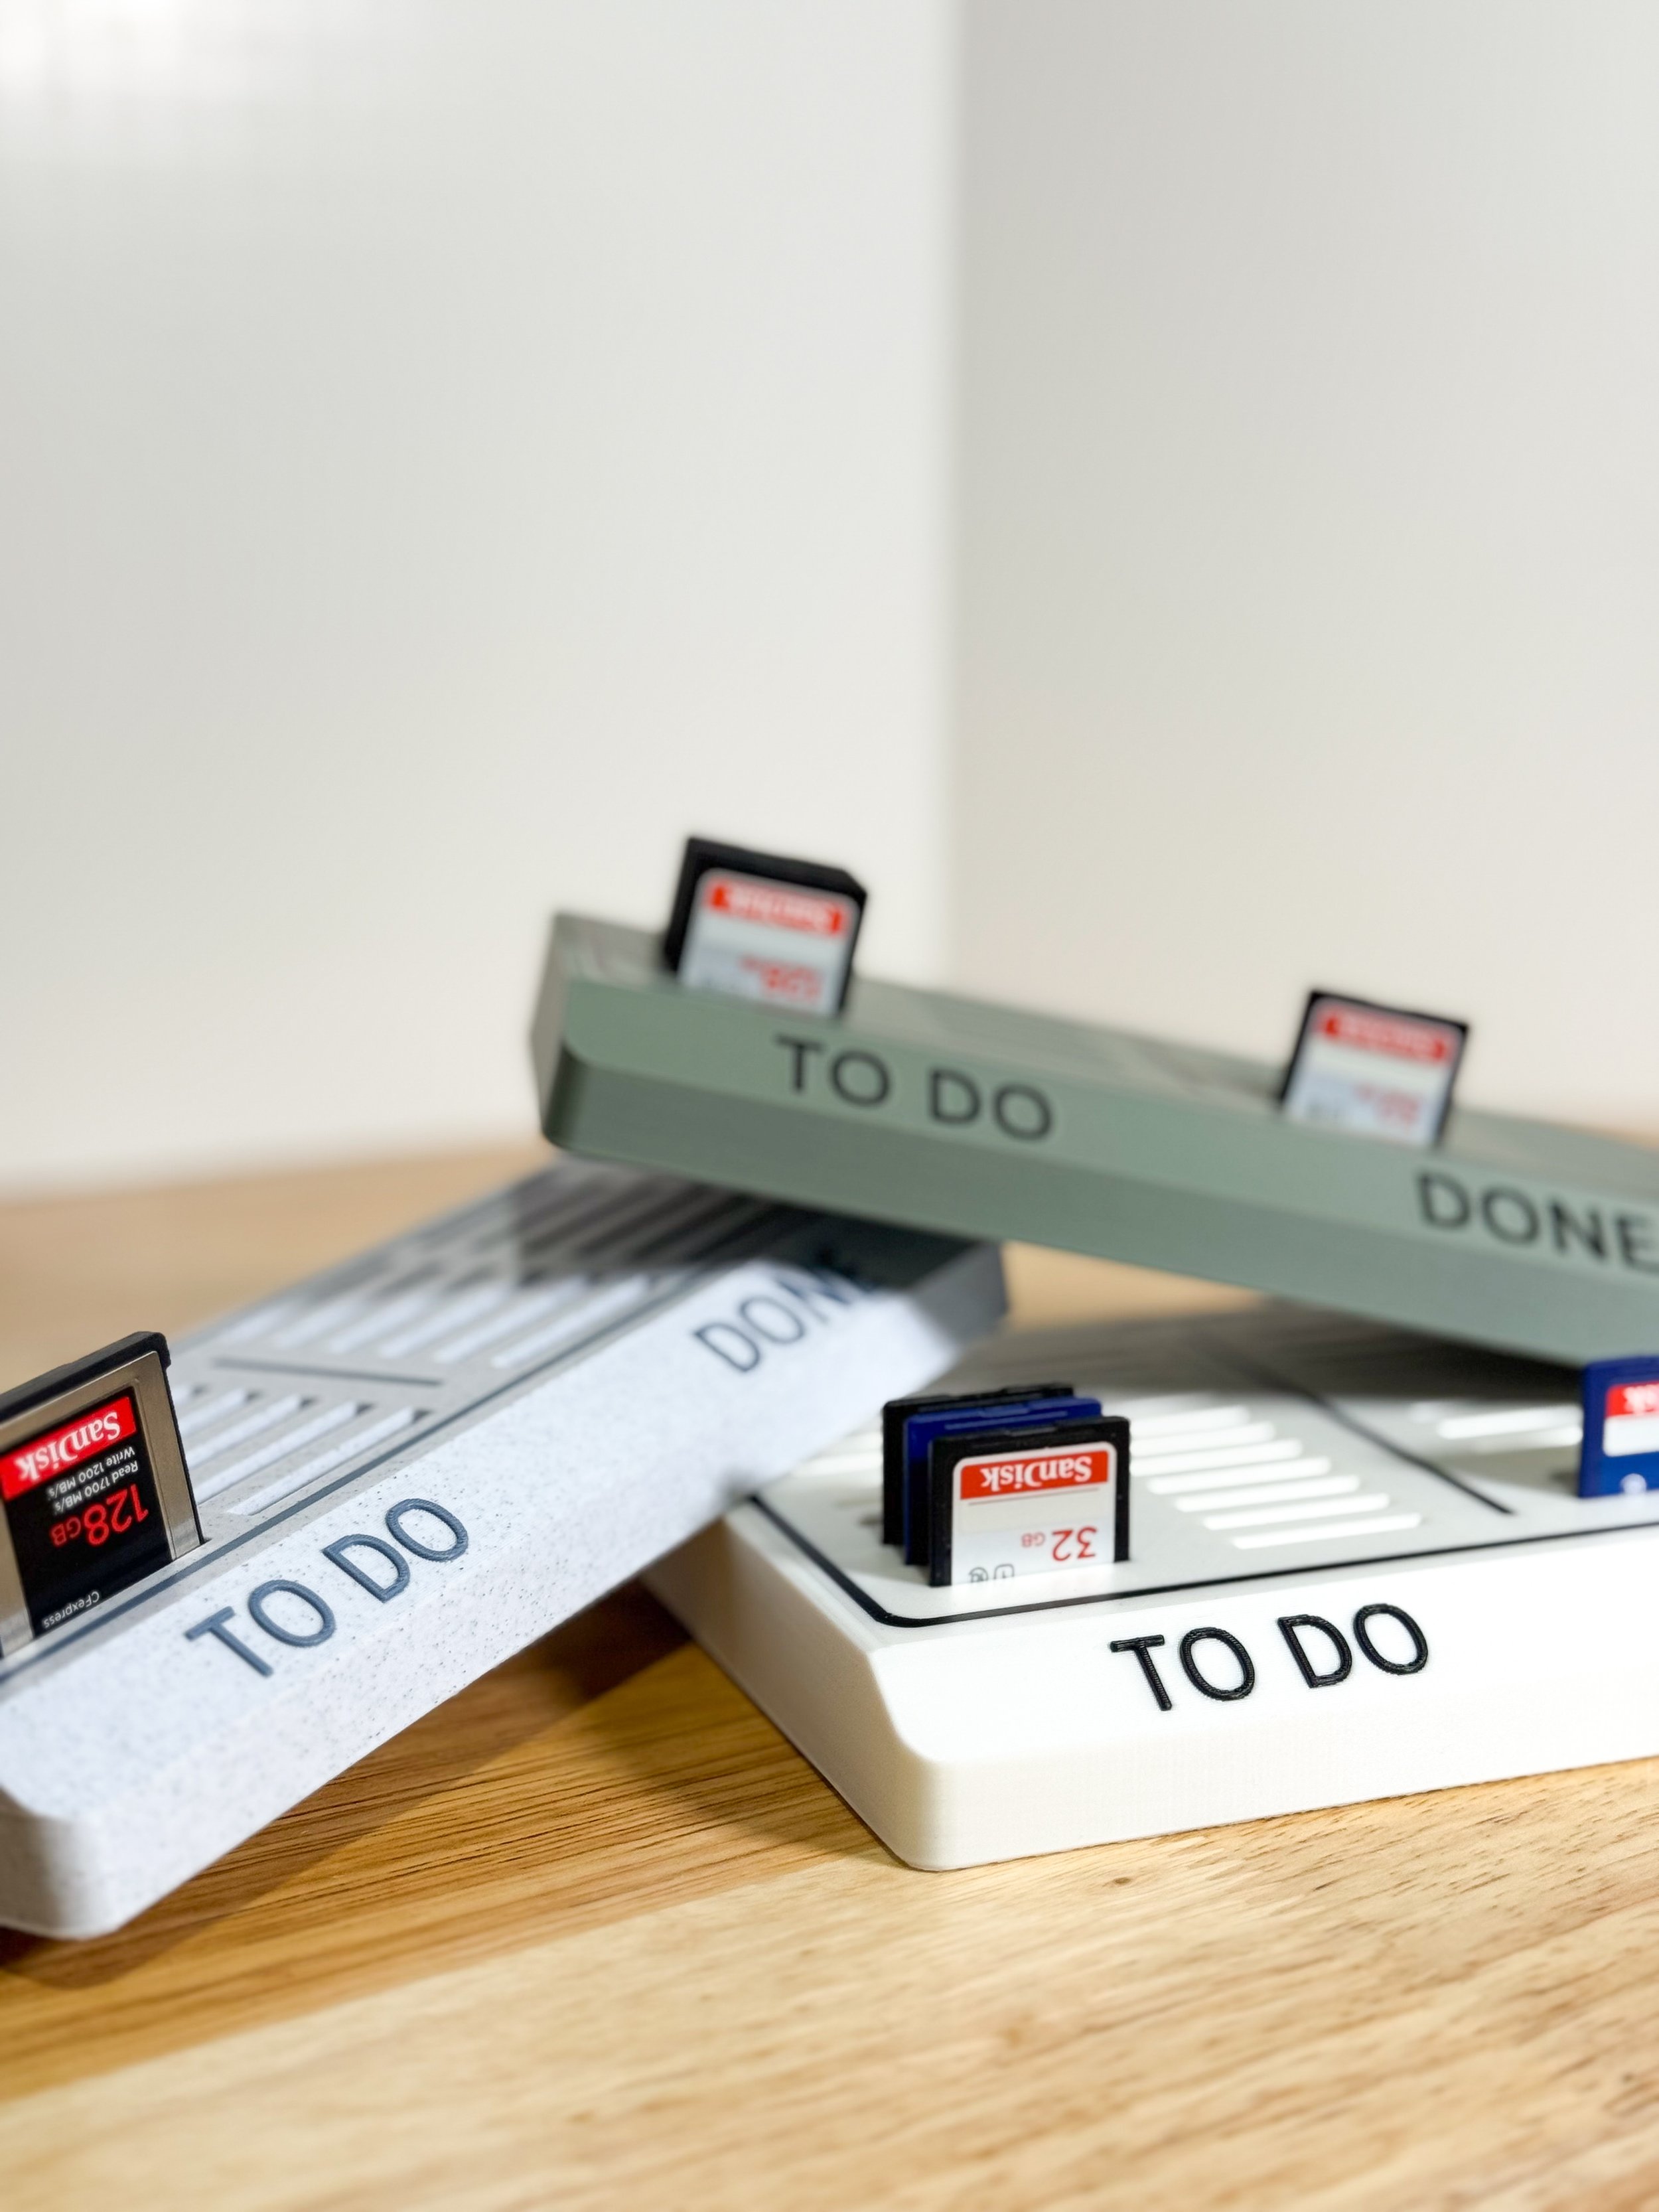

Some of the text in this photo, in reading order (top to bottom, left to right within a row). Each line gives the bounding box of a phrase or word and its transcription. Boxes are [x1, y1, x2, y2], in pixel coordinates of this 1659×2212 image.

[775, 1033, 1054, 1143] TO DO
[1415, 1168, 1659, 1276] DONE
[14, 1412, 121, 1481] SanDisk
[106, 1446, 136, 1466] Write
[78, 1462, 105, 1483] 1200
[84, 1479, 111, 1498] 1700
[111, 1460, 139, 1483] Read
[979, 1456, 1092, 1492] SanDisk
[1021, 1525, 1097, 1561] 32 GB
[184, 1498, 469, 1678] TO DO
[43, 1591, 100, 1628] CFexpress
[1109, 1603, 1429, 1712] TO DO
